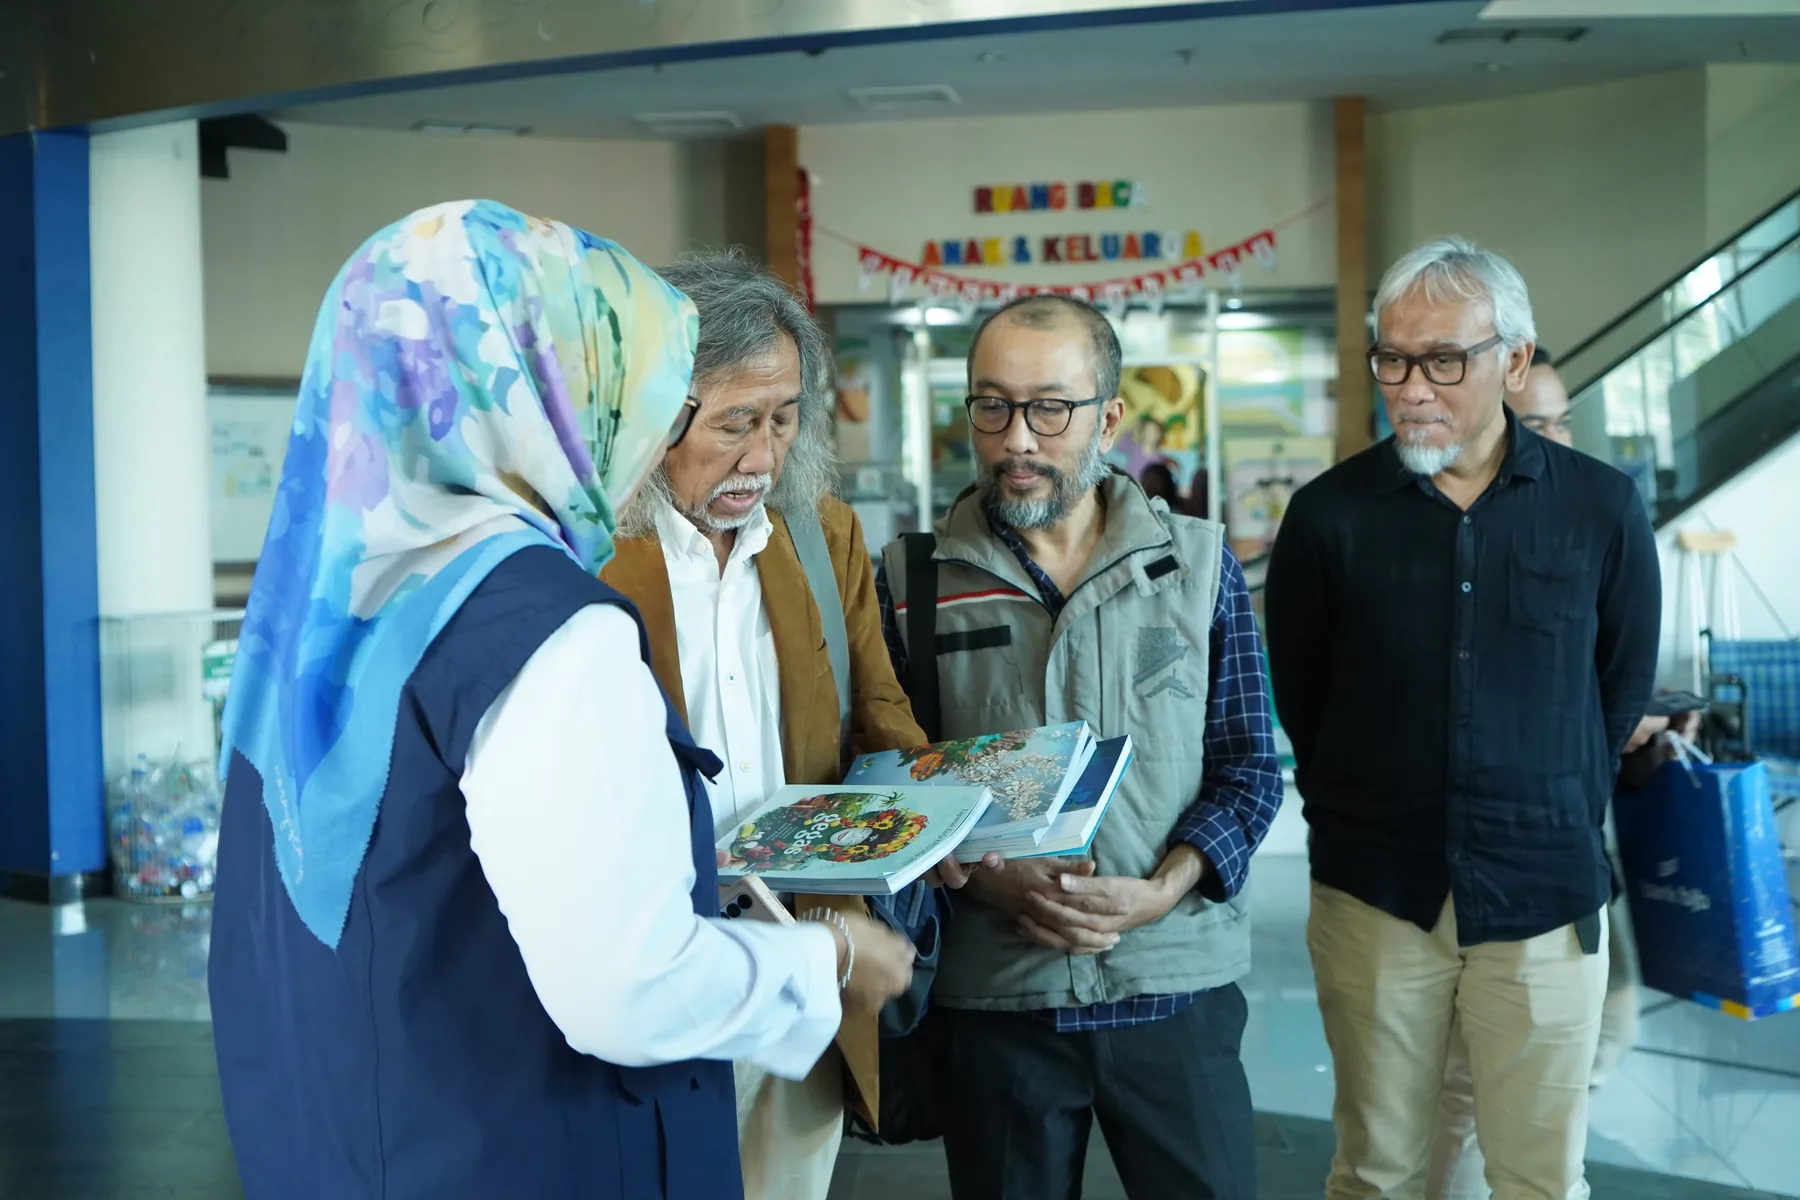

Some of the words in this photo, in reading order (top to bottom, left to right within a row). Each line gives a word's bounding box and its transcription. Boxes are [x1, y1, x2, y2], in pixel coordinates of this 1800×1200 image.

[974, 183, 1067, 214] RUANG
[1077, 179, 1147, 210] BACA
[922, 236, 1004, 267] ANAK
[1013, 235, 1031, 264] &
[1042, 230, 1203, 264] KELUARGA
[783, 812, 842, 855] gegas
